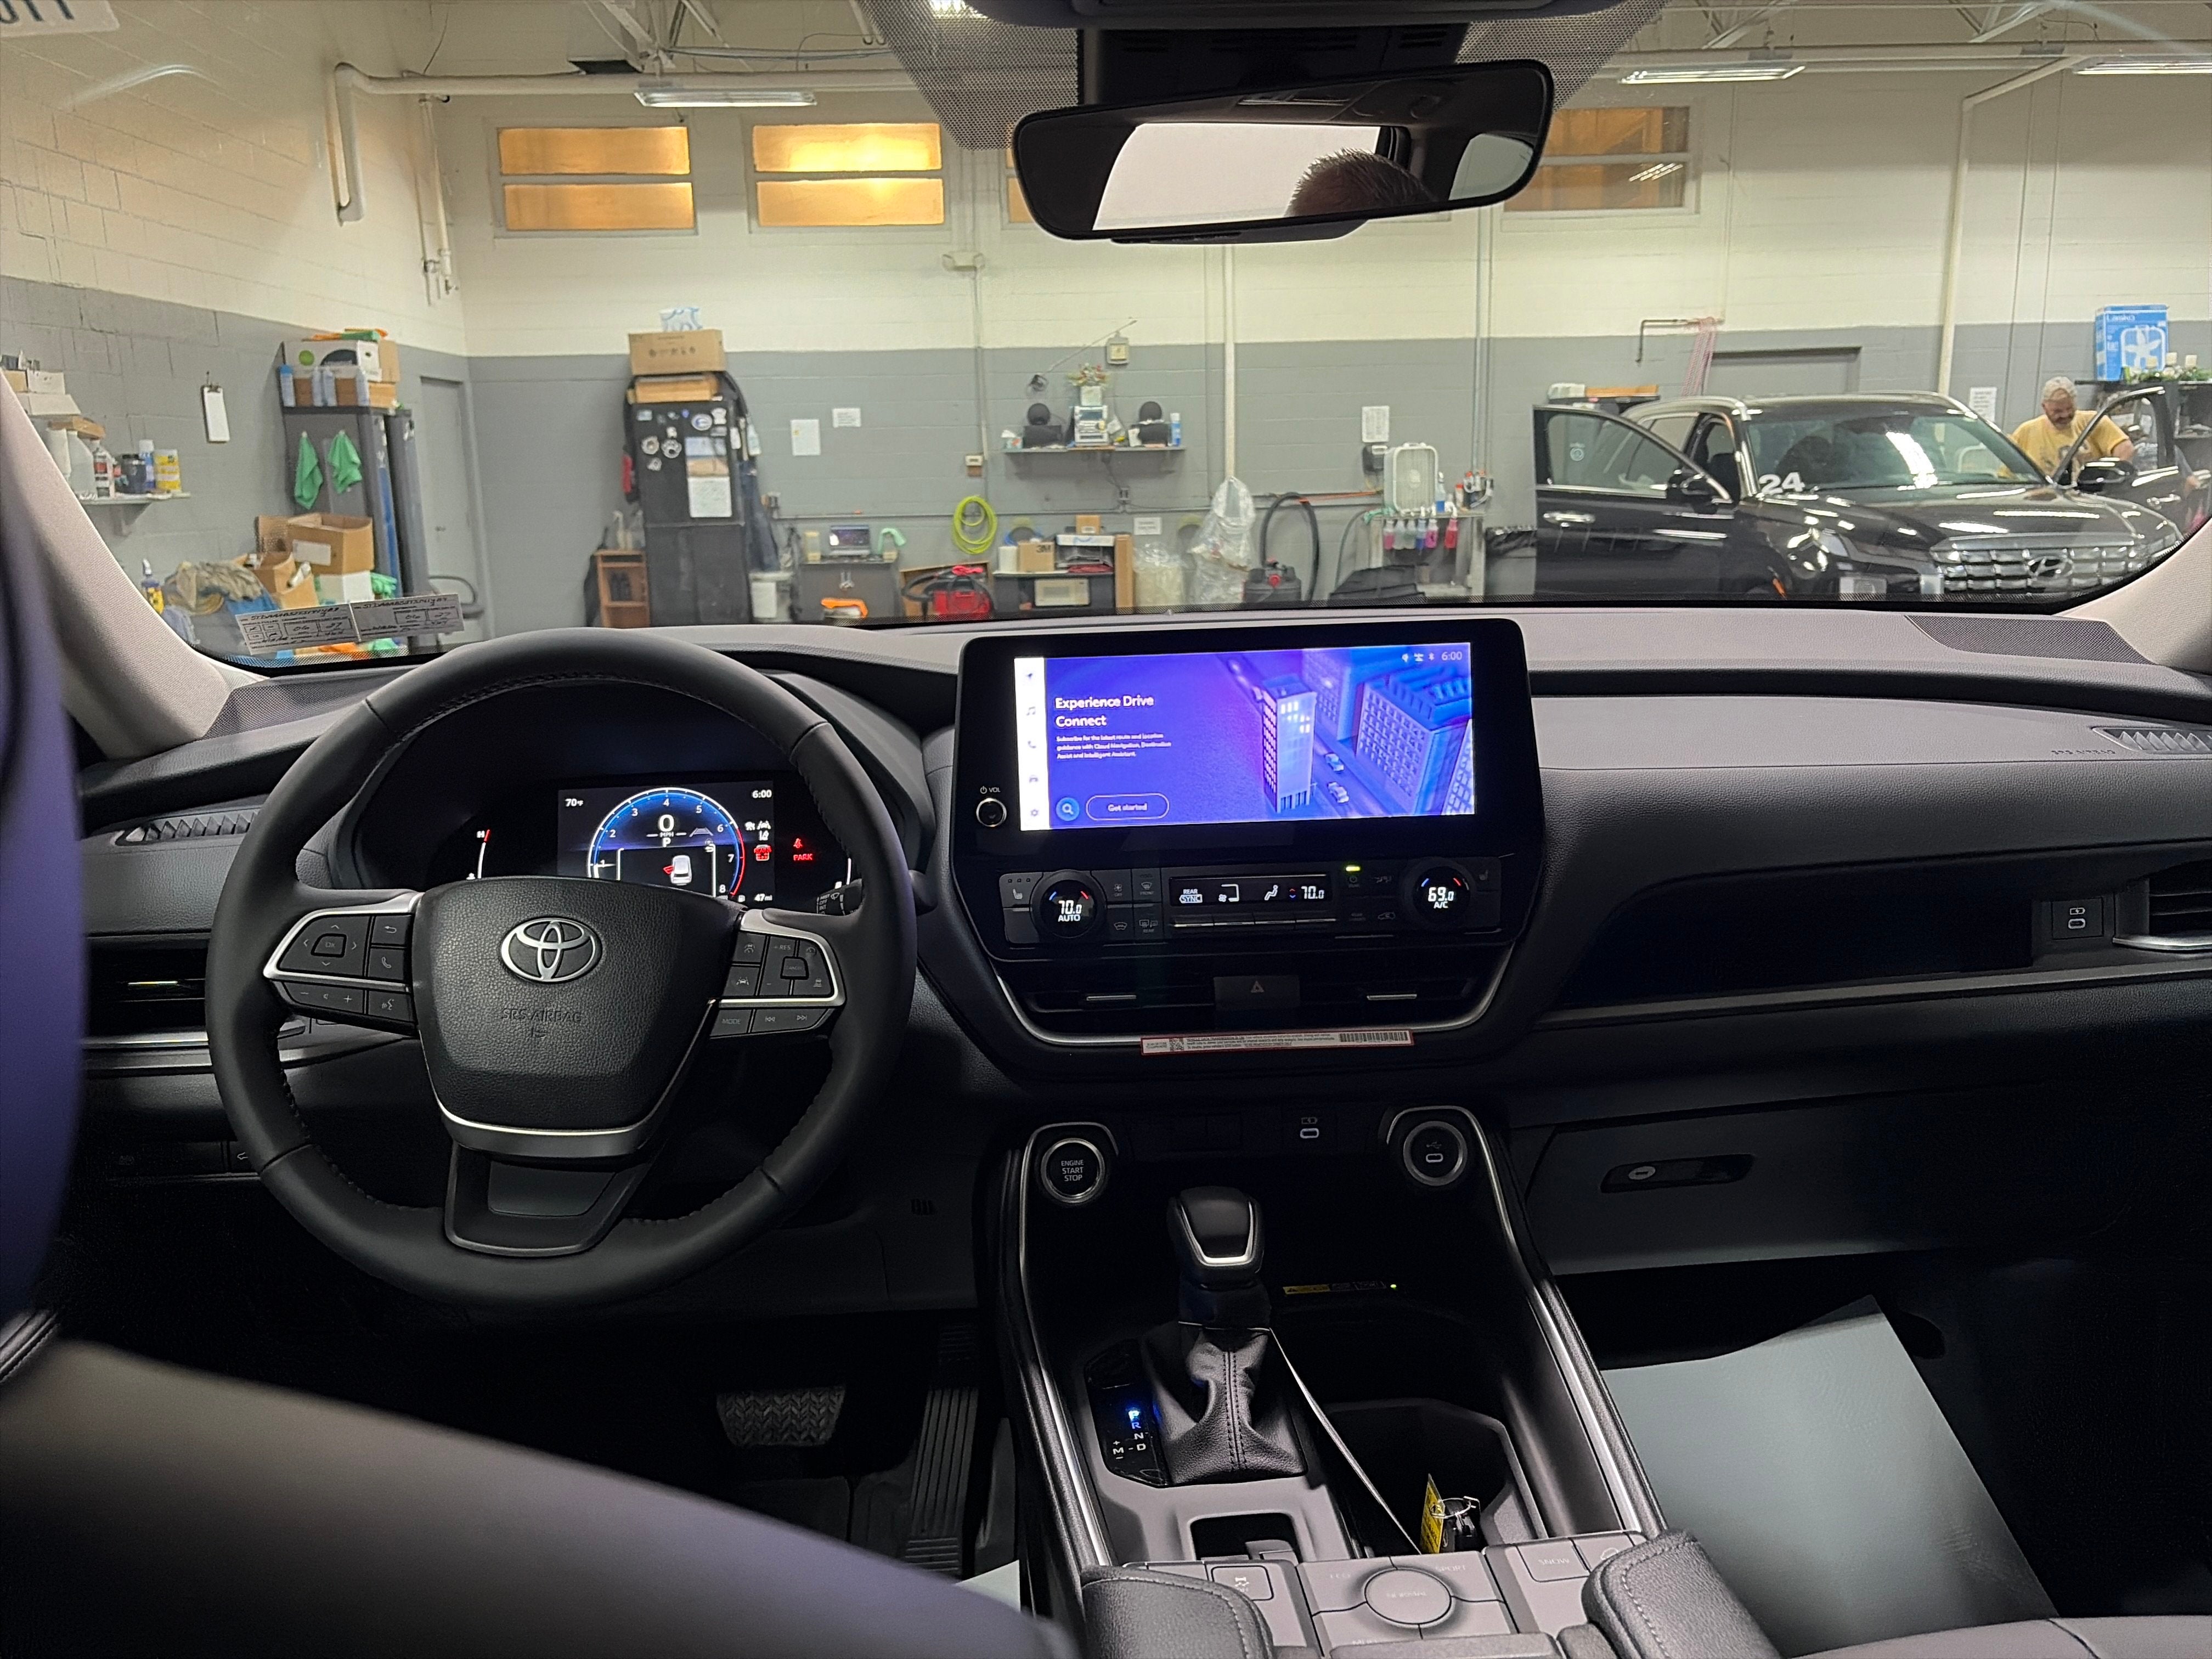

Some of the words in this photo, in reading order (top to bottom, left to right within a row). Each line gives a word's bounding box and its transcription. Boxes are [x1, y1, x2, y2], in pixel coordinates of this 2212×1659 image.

[1759, 472, 1805, 494] 24
[1036, 544, 1052, 552] 3M
[1441, 651, 1463, 661] 6:00
[1055, 696, 1121, 710] Experience
[1123, 695, 1154, 707] Drive
[1056, 715, 1107, 727] Connect
[752, 789, 772, 799] 6:00
[663, 799, 670, 807] 4
[631, 808, 638, 817] 3
[696, 805, 702, 814] 5
[1108, 804, 1122, 812] Get
[659, 814, 675, 832] 0
[716, 824, 724, 833] 6
[476, 830, 486, 838] H
[609, 829, 616, 838] 2
[662, 837, 671, 848] P
[727, 854, 735, 863] 7
[719, 884, 726, 894] 8
[1301, 885, 1325, 899] 70.0
[1427, 887, 1454, 901] 69.0
[1058, 900, 1082, 915] 70.0
[1058, 914, 1081, 922] AUTO
[501, 1008, 527, 1020] SRS
[531, 1008, 583, 1023] AIRBAG
[1062, 1166, 1084, 1175] START
[1128, 1410, 1140, 1421] P
[1133, 1432, 1144, 1440] N
[1113, 1447, 1124, 1455] M
[1136, 1442, 1146, 1451] D
